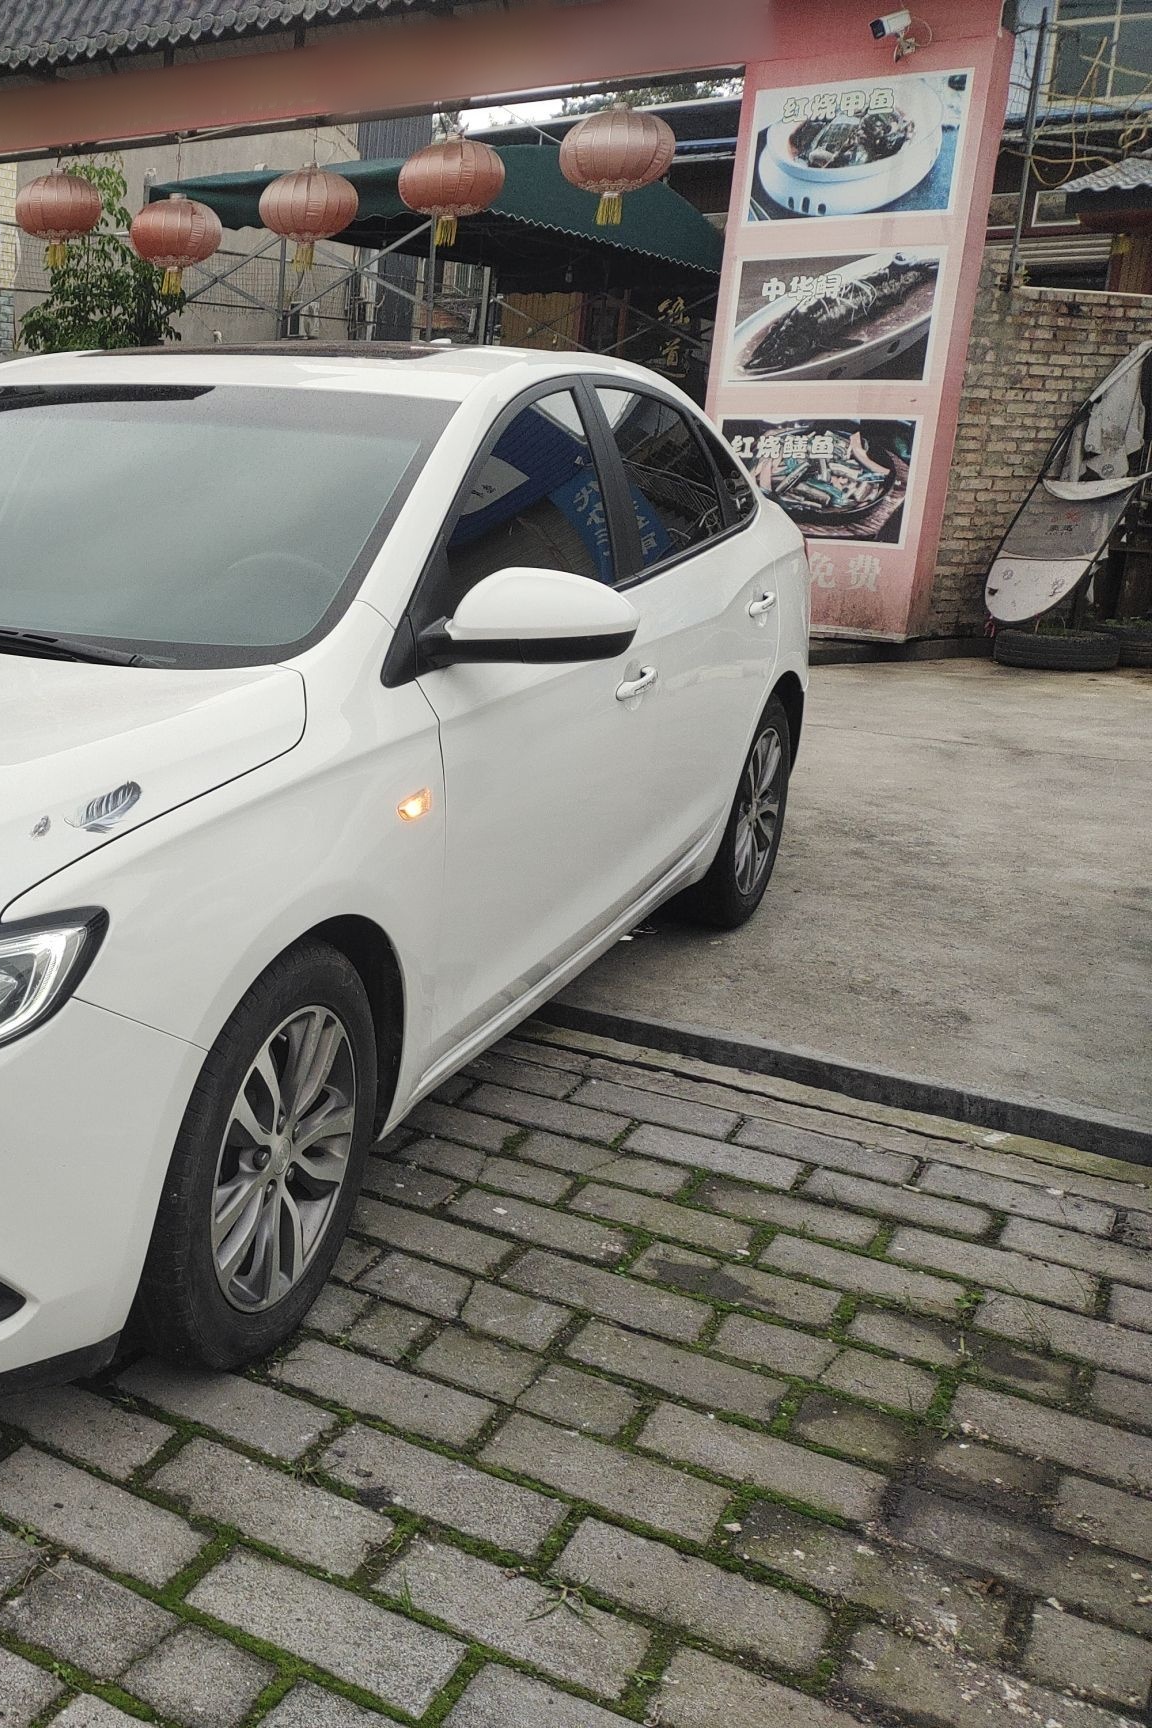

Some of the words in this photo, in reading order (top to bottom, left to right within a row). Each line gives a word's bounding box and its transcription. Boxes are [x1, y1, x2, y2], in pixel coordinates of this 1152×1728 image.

[782, 88, 895, 123] 红烧甲鱼
[762, 274, 842, 301] 中华鲟
[731, 435, 834, 459] 红烧鳝鱼
[809, 551, 881, 592] 免费
